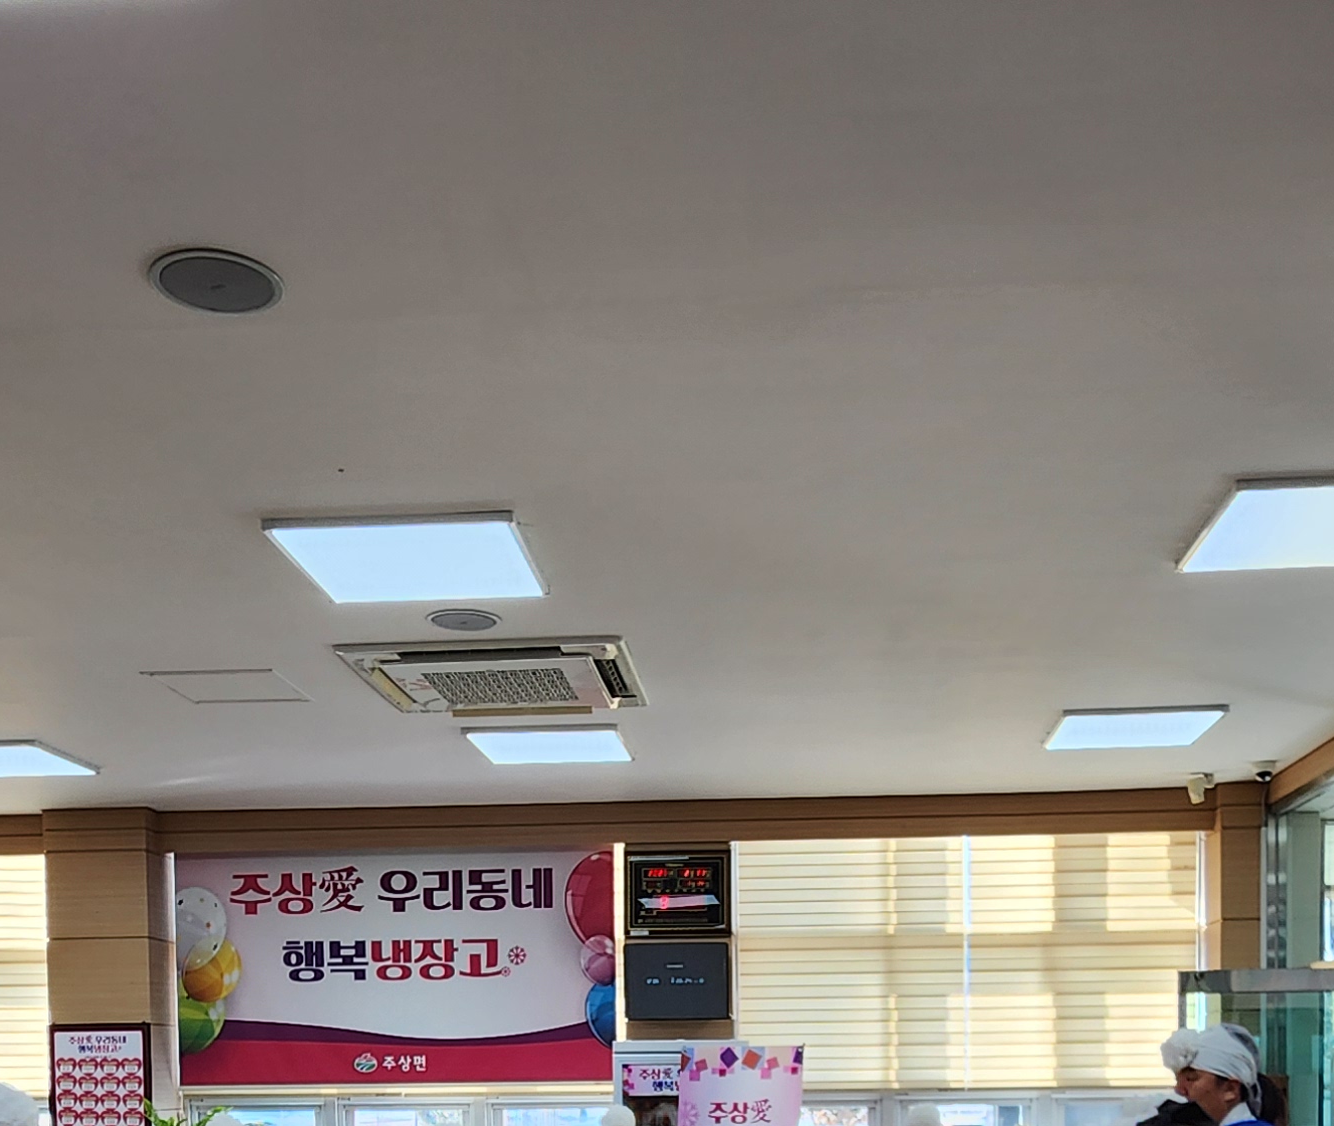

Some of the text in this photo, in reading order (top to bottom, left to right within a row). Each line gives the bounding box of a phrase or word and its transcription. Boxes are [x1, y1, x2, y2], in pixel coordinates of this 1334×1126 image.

[229, 865, 554, 915] 주상愛 우리동네
[282, 938, 504, 982] 행복냉장고
[381, 1054, 427, 1072] 주상면
[708, 1099, 772, 1124] 주상愛
